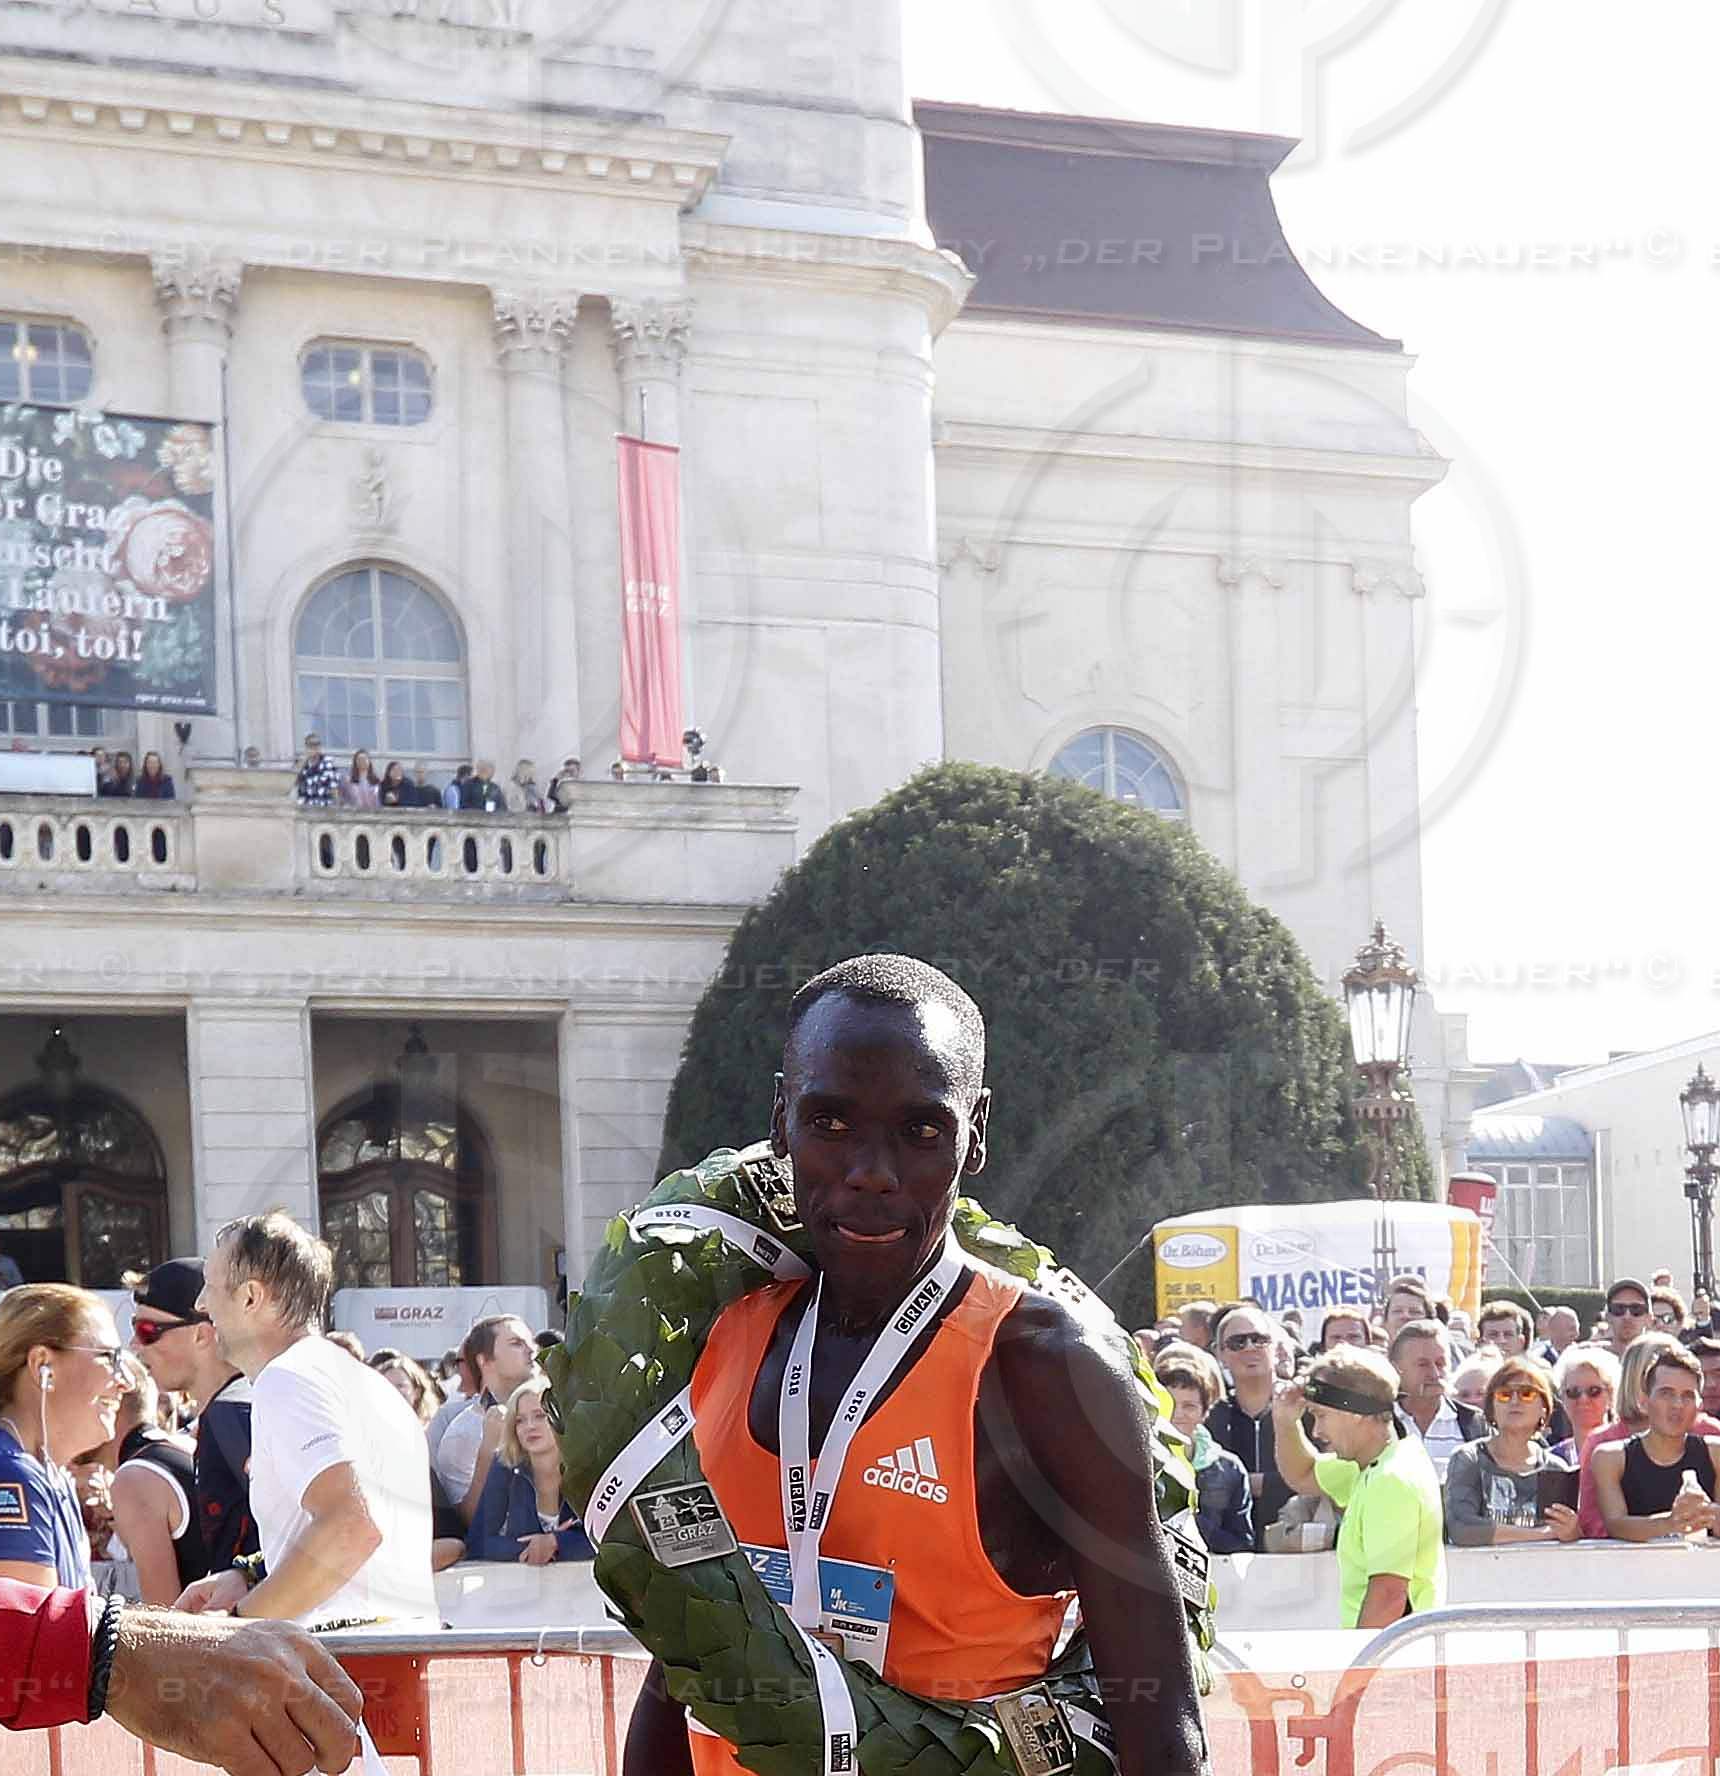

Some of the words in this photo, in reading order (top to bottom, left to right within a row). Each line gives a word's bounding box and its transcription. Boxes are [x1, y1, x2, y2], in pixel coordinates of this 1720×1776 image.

[36, 493, 130, 533] Graz
[8, 578, 169, 622] Läufern
[76, 628, 145, 663] toi!
[896, 1280, 941, 1334] GRAZ
[1250, 1266, 1427, 1312] MAGNES
[400, 1306, 445, 1320] GRAZ
[788, 1364, 802, 1397] 2018
[843, 1389, 868, 1423] 2018
[596, 1475, 623, 1512] 2018
[789, 1466, 806, 1532] GRAZ
[863, 1466, 949, 1504] adidas
[678, 1522, 717, 1542] GRAZ
[840, 1735, 849, 1770] KLEINE
